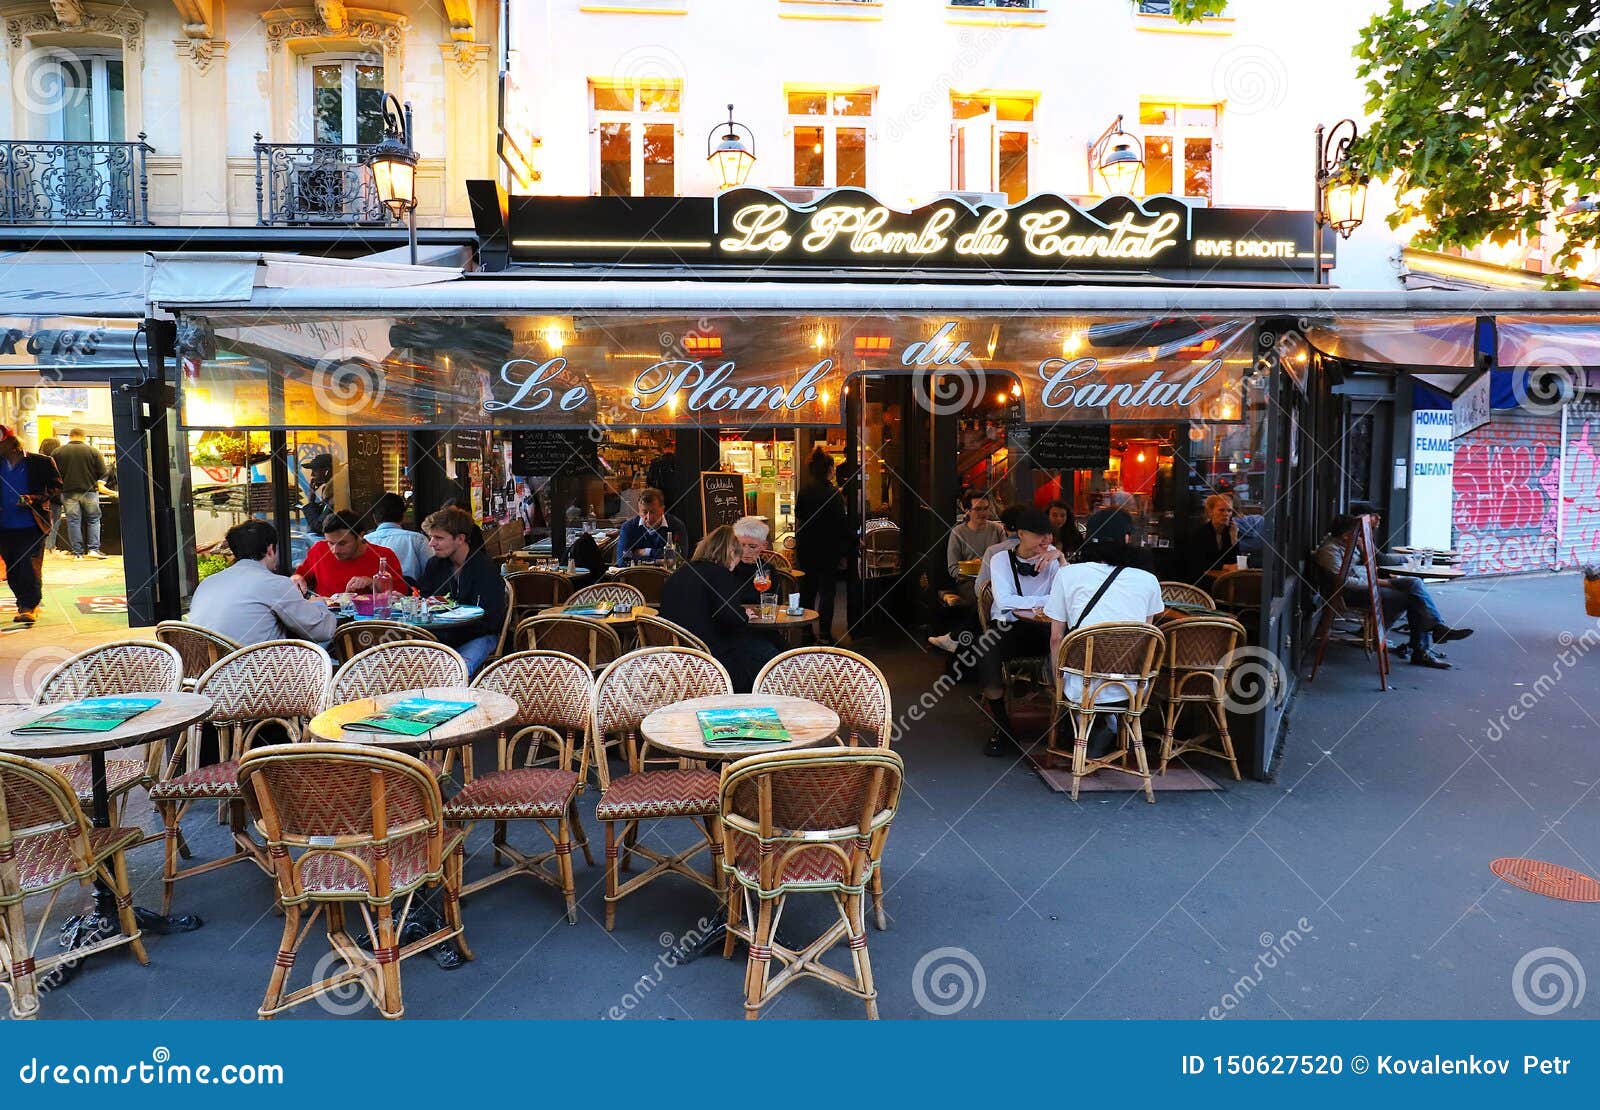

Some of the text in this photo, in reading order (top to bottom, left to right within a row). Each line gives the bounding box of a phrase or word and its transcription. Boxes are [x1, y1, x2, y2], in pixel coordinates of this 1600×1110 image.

[720, 204, 1181, 258] Le Plomb du Cantal
[1195, 239, 1296, 258] RIVE DROITE
[484, 321, 1223, 413] Le Plomb du Cantal
[1416, 411, 1453, 425] HOMME
[1416, 437, 1453, 451] FEMME
